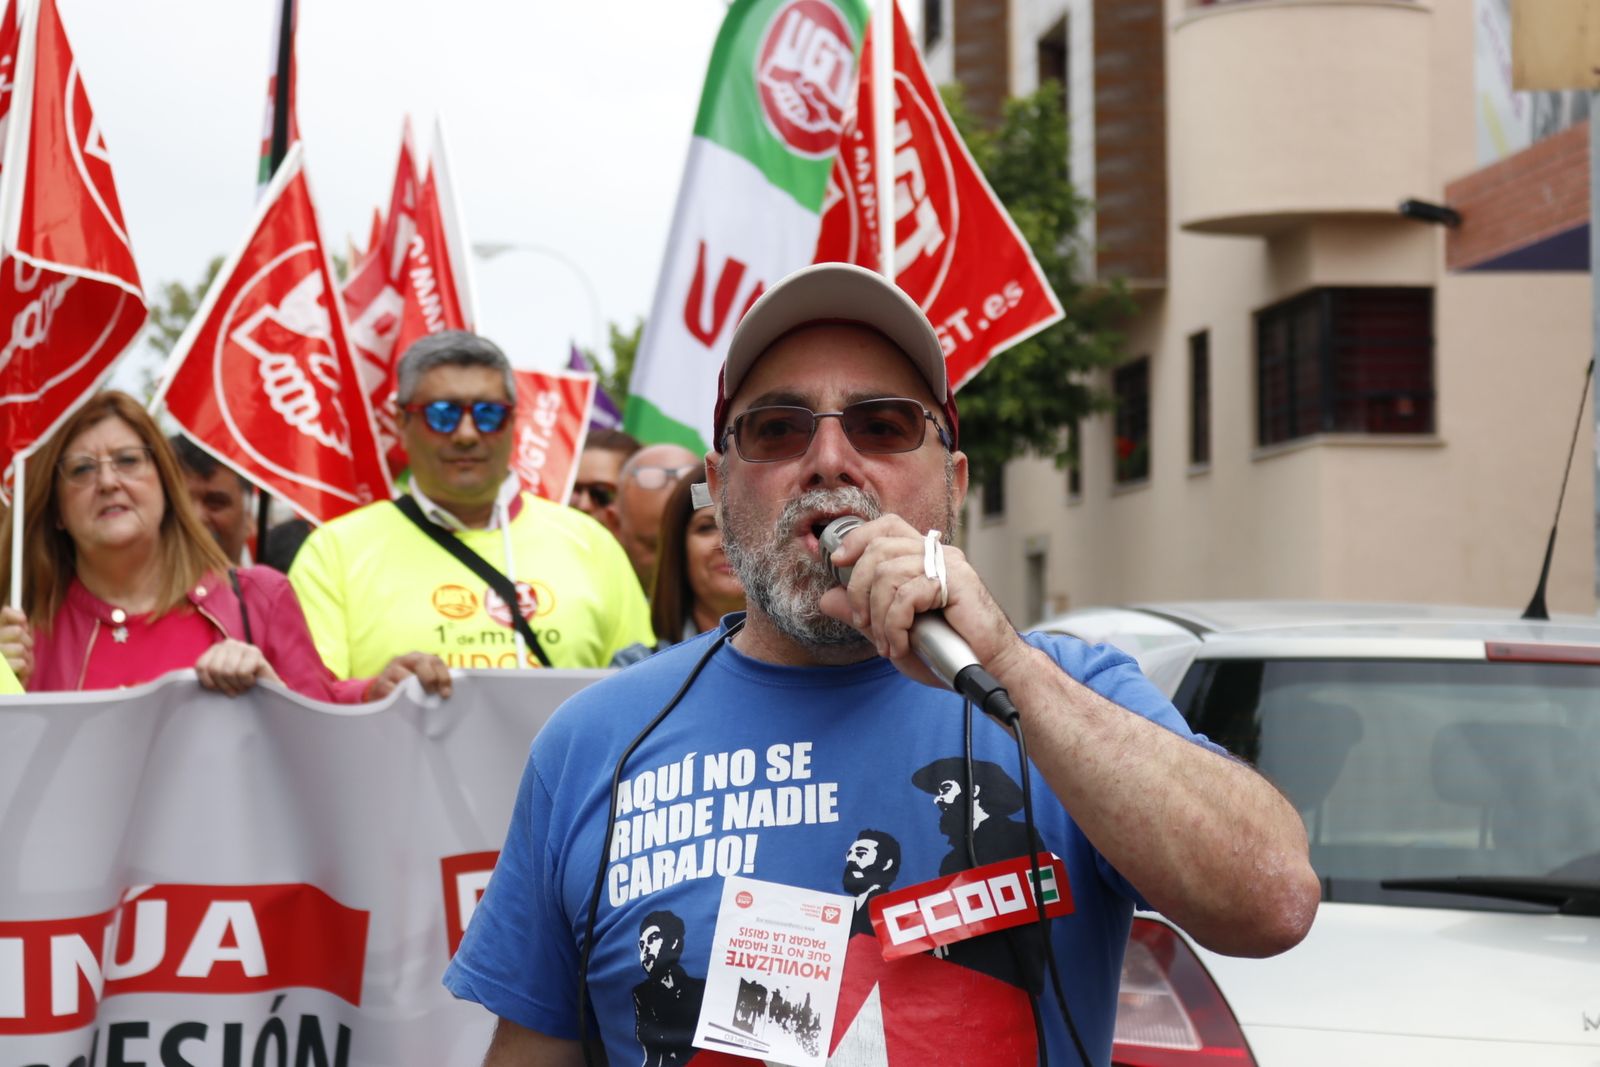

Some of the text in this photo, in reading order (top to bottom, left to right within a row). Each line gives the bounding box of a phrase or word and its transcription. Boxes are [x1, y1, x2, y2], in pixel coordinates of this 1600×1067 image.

[616, 742, 813, 818] AQUÍ NO SE
[609, 782, 839, 863] RINDE NADIE
[608, 834, 758, 908] CARAJO!
[739, 927, 826, 950] PAGAR LA CRISIS
[882, 872, 1027, 946] CCOO
[725, 950, 831, 981] MOVILÍZATE
[729, 937, 832, 962] QUE NO TE HAGAN
